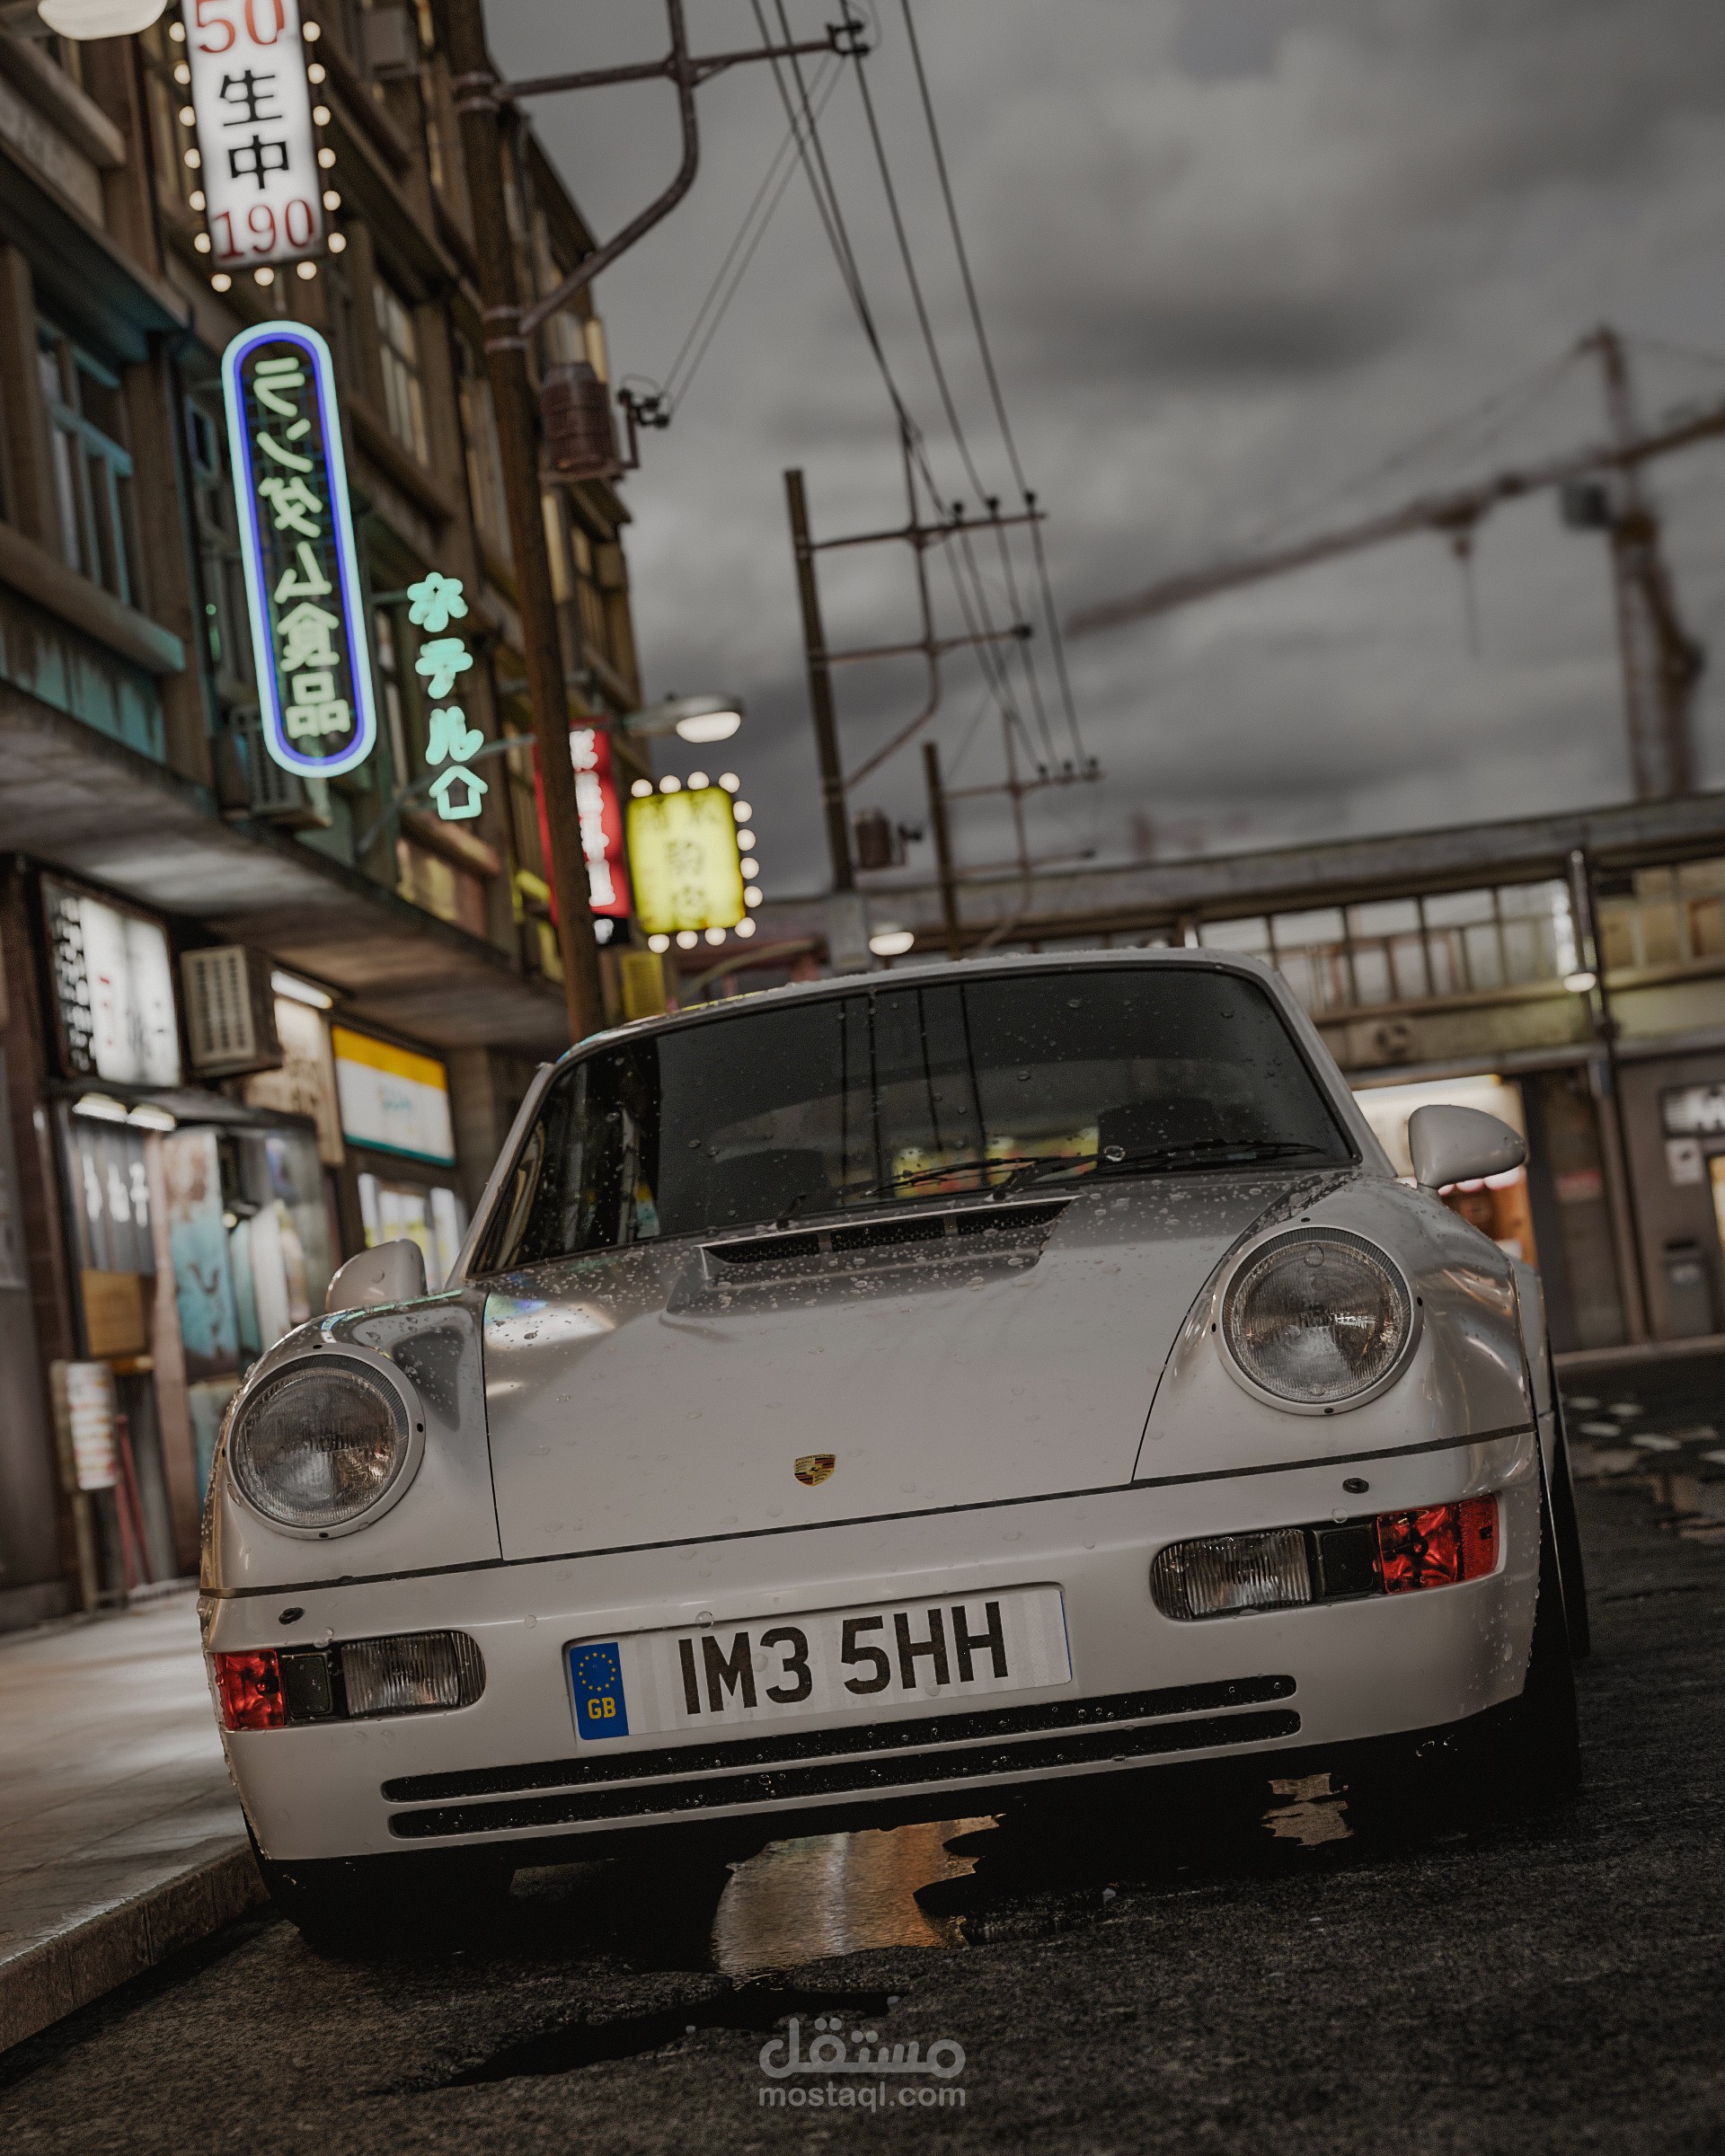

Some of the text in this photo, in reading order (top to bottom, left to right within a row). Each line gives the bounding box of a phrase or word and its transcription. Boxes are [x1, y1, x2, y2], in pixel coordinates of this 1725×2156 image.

[219, 69, 289, 190] 生中
[211, 199, 314, 260] 190
[841, 1600, 1009, 1695] 5HH
[588, 1696, 616, 1719] GB
